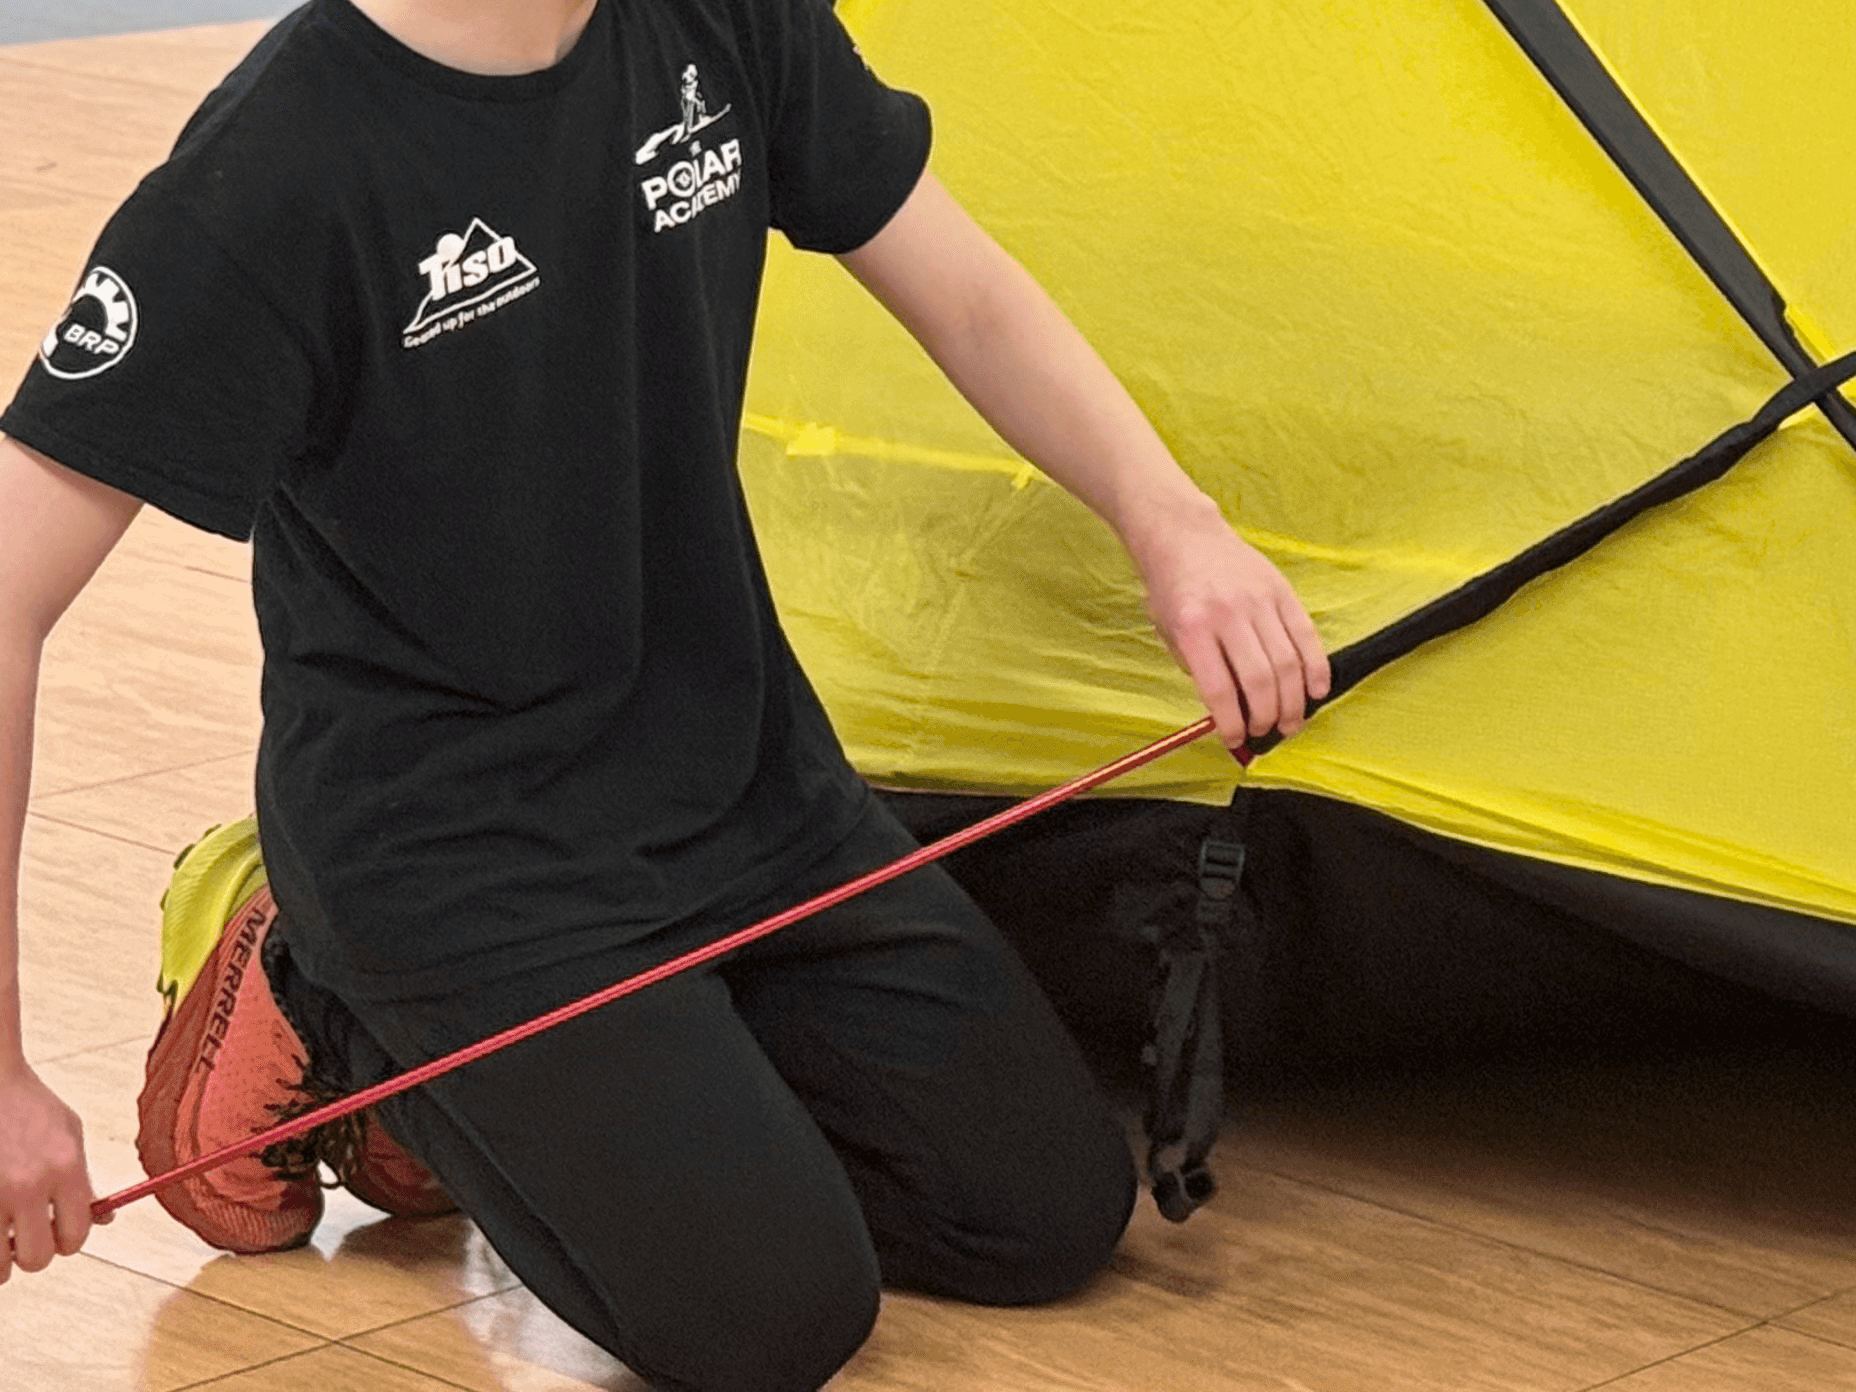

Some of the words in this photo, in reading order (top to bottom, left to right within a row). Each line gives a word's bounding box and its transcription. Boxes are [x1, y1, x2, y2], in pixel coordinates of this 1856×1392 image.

[640, 138, 742, 211] POLAR
[63, 323, 120, 355] BRP
[199, 908, 267, 1071] MERRELL
